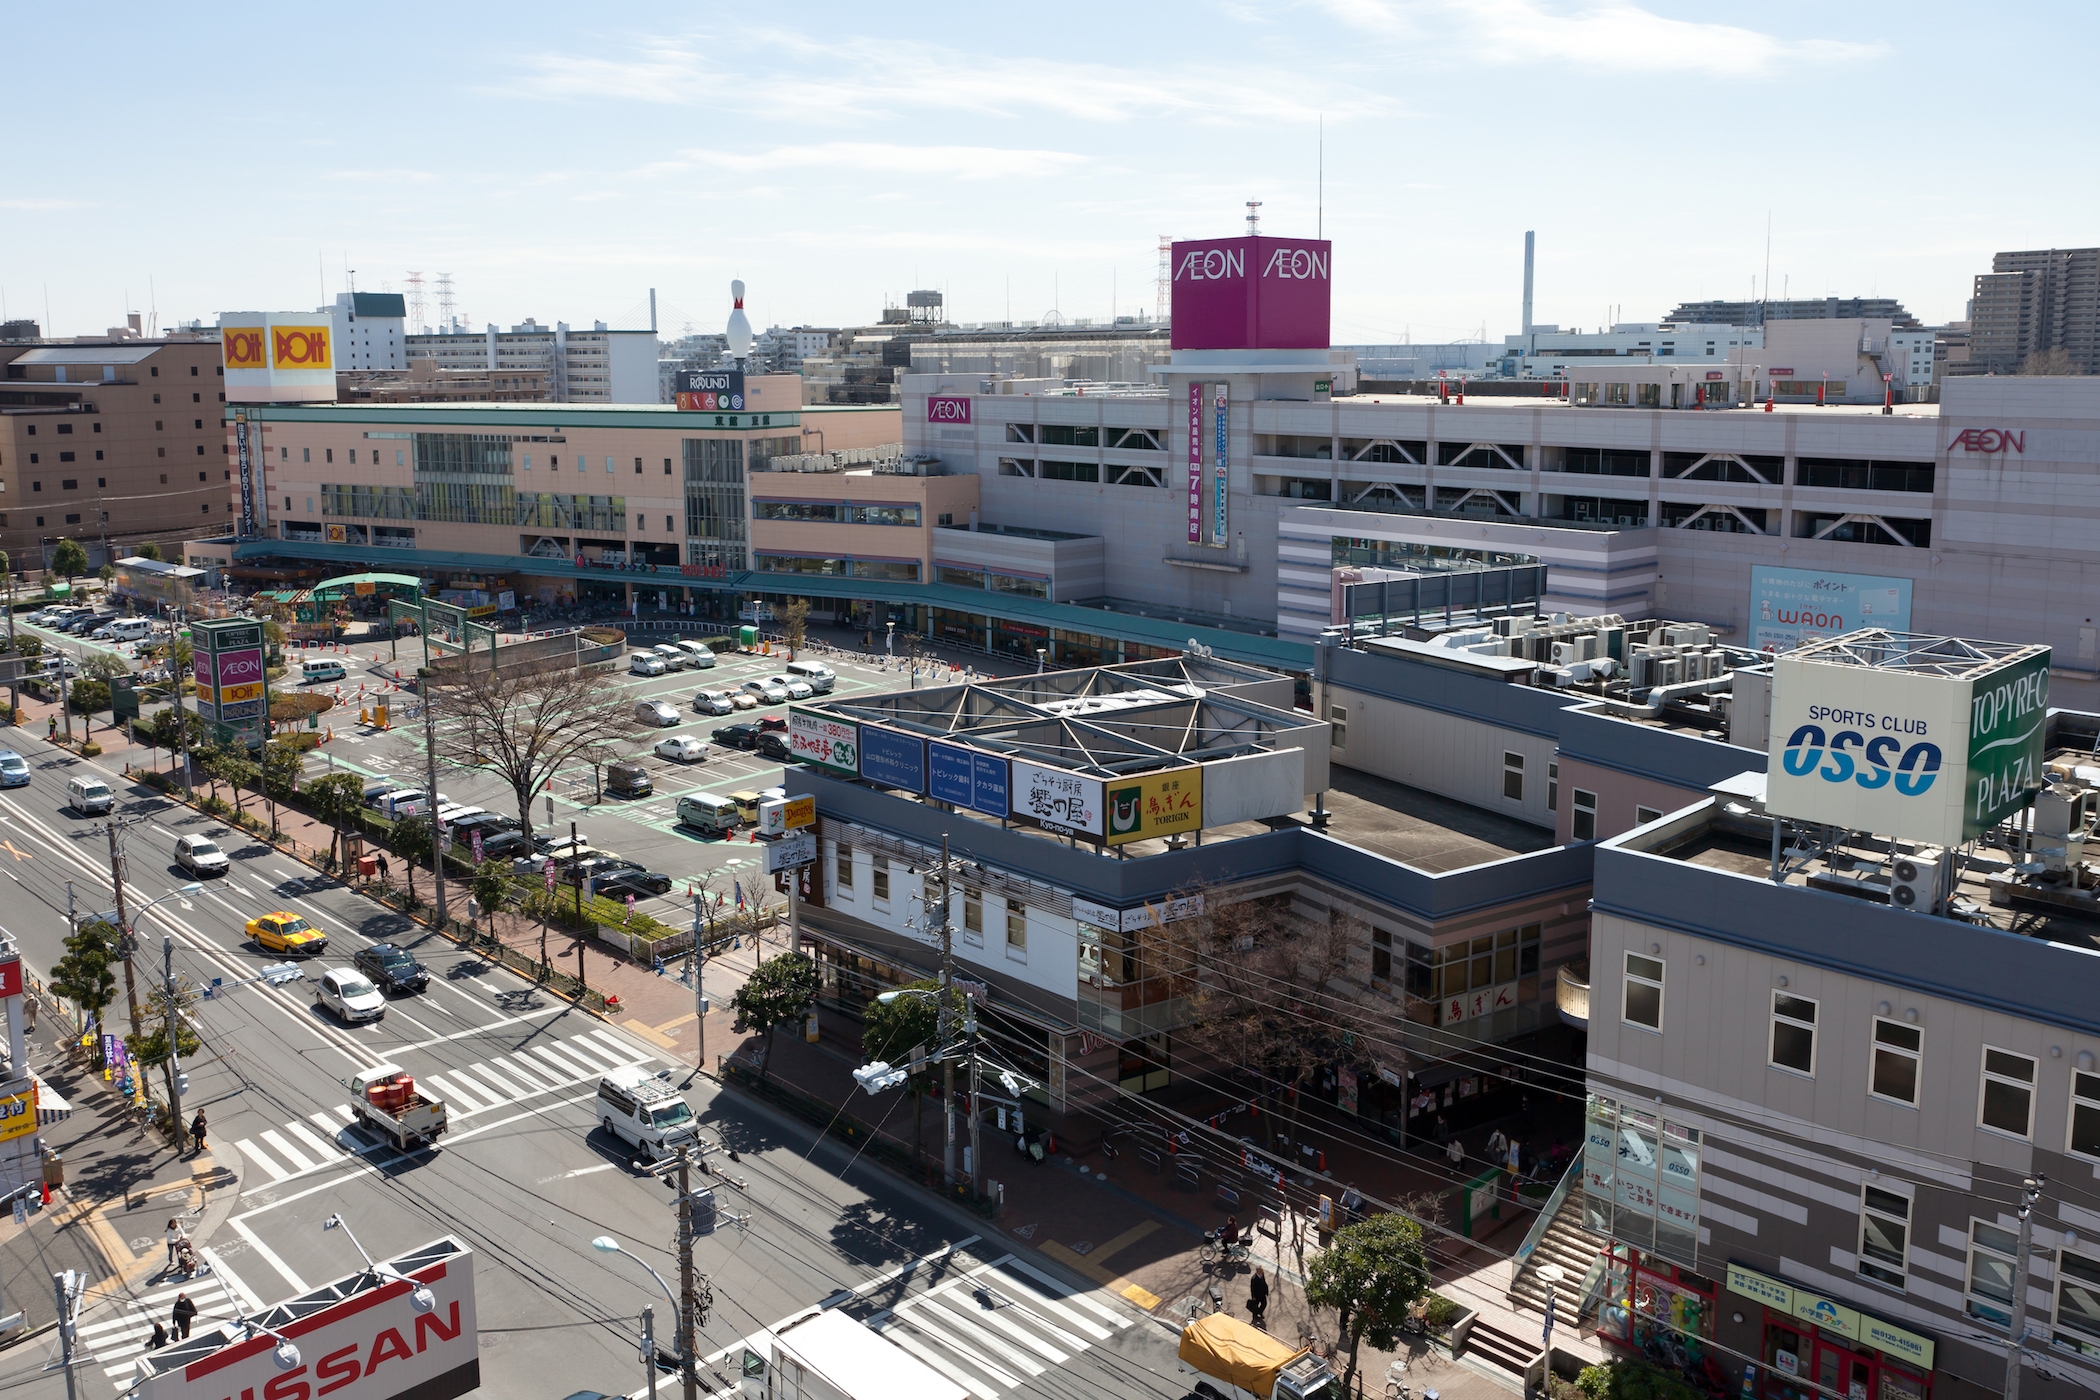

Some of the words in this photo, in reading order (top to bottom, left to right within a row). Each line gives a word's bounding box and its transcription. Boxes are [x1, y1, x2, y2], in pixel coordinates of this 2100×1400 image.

[1189, 475, 1200, 534] 7時開店
[1972, 666, 2049, 739] TOPYREC
[1809, 705, 1876, 728] SPORTS
[1882, 716, 1928, 735] CLUB
[1782, 724, 1942, 797] OSSO
[976, 780, 1005, 795] タカラ薬局
[1032, 772, 1082, 796] ごちそう厨房
[1161, 781, 1180, 792] 銀座
[1976, 752, 2034, 820] PLAZA
[786, 803, 813, 821] Denny's
[1154, 812, 1190, 826] TORIGIN
[1039, 819, 1074, 836] Kyo-no-ya
[1448, 987, 1514, 1021] 鳥ぎん
[1590, 1135, 1610, 1148] OSSO
[1668, 1162, 1690, 1176] OSSO
[1617, 1178, 1653, 1198] いつでも
[1628, 1192, 1654, 1207] ご見学
[1799, 1305, 1853, 1331] 小学館アカデミー
[1880, 1330, 1922, 1352] 0120-415861
